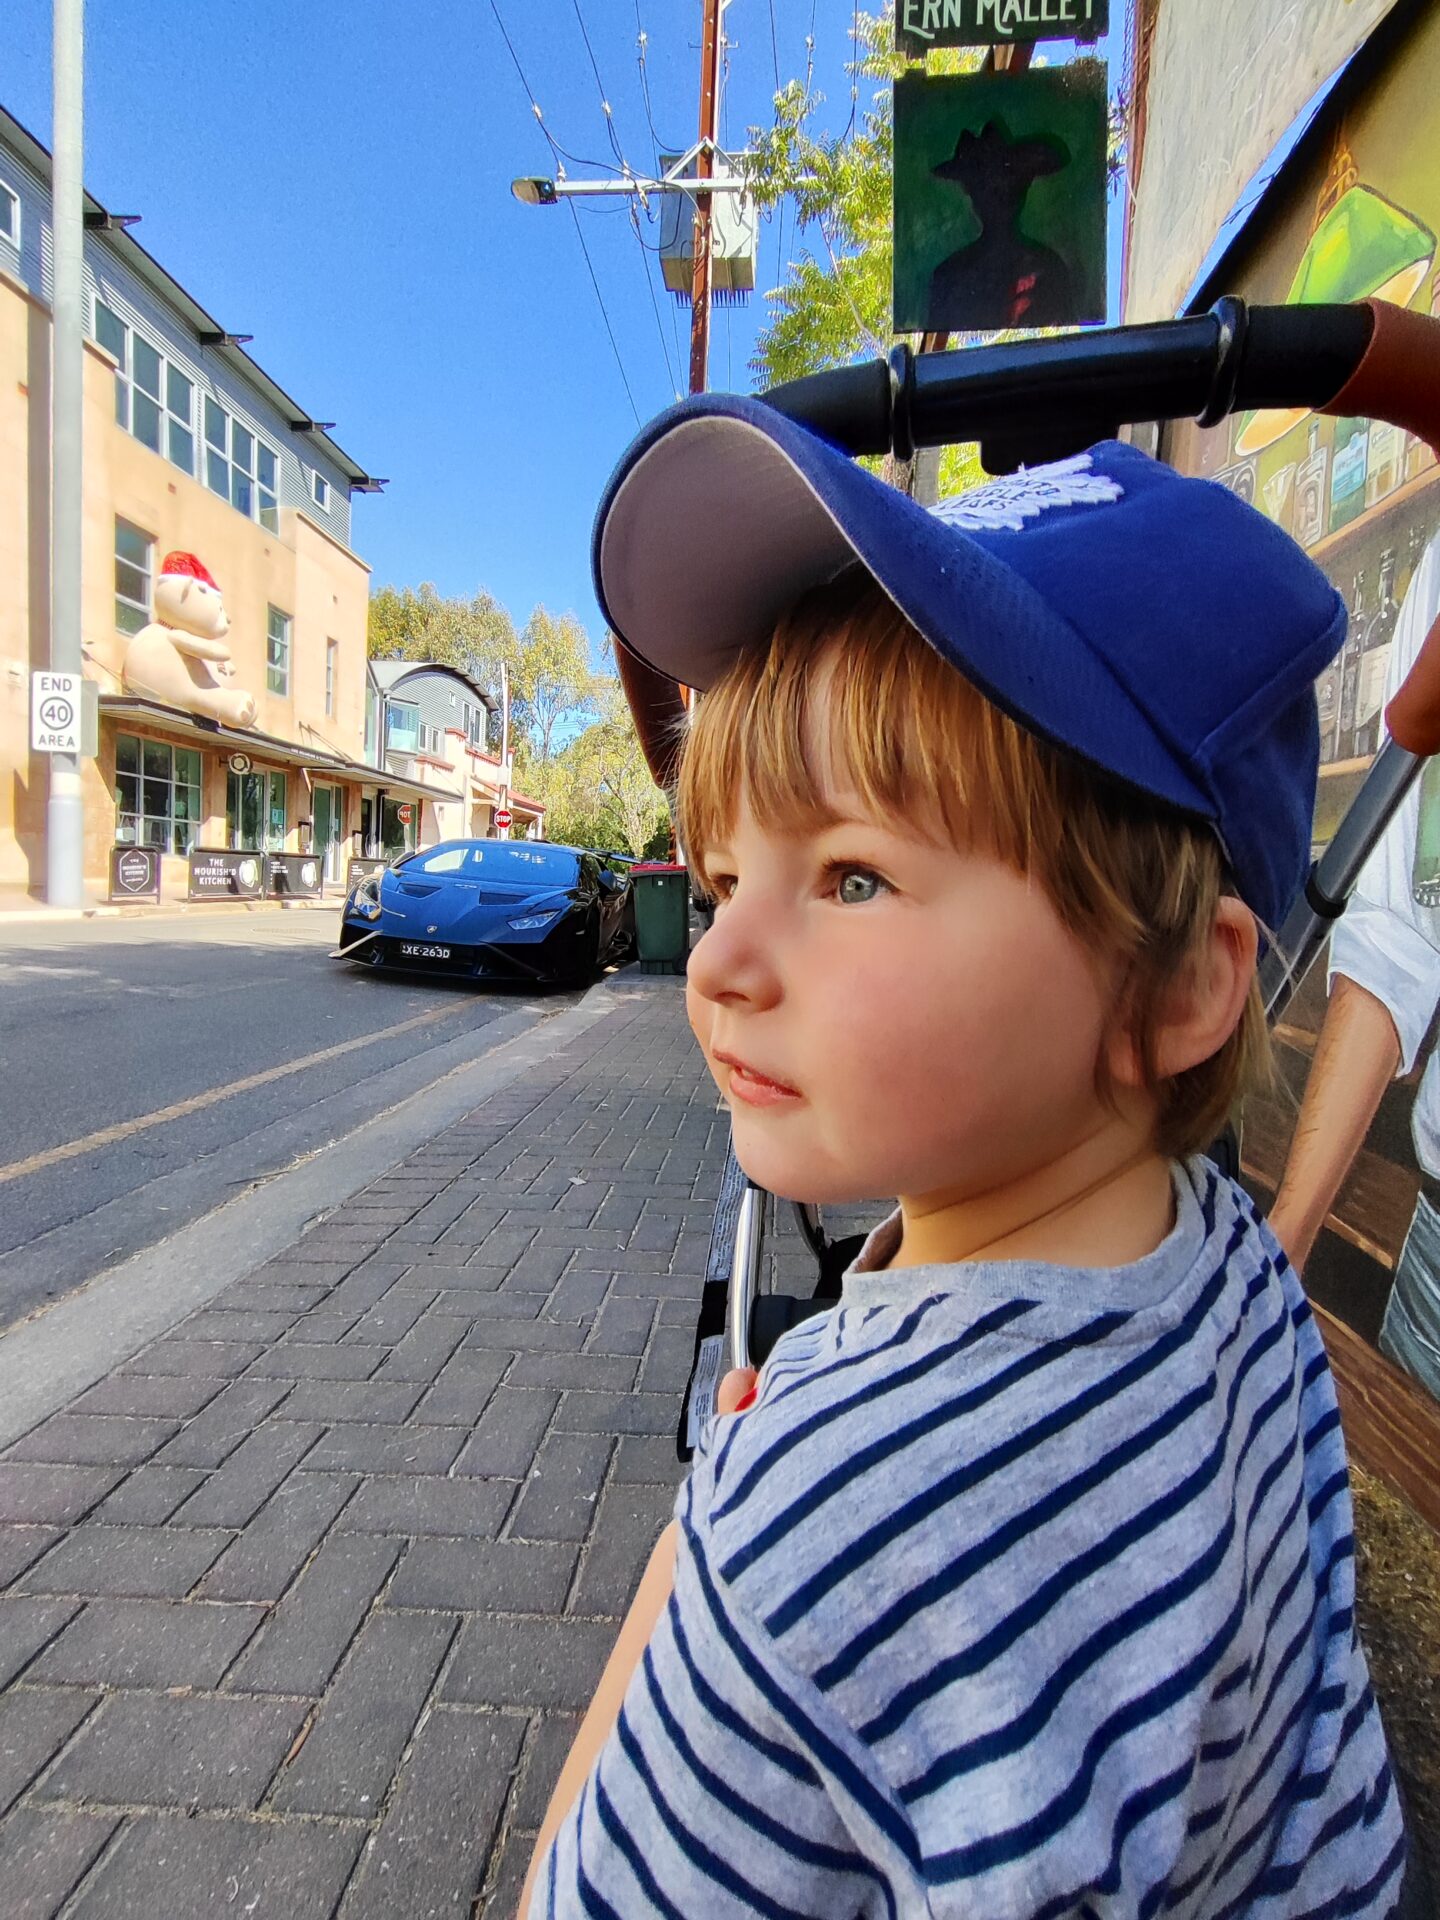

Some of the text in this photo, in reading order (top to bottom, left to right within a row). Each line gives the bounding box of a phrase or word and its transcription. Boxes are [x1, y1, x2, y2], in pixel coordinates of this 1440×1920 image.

[903, 0, 961, 39] ERN
[41, 676, 72, 692] END
[45, 705, 69, 722] 40
[38, 734, 76, 748] AREA
[495, 815, 512, 823] STOP
[209, 858, 224, 867] THE
[193, 867, 237, 876] NOURISH'D
[199, 877, 232, 886] KITCHEN
